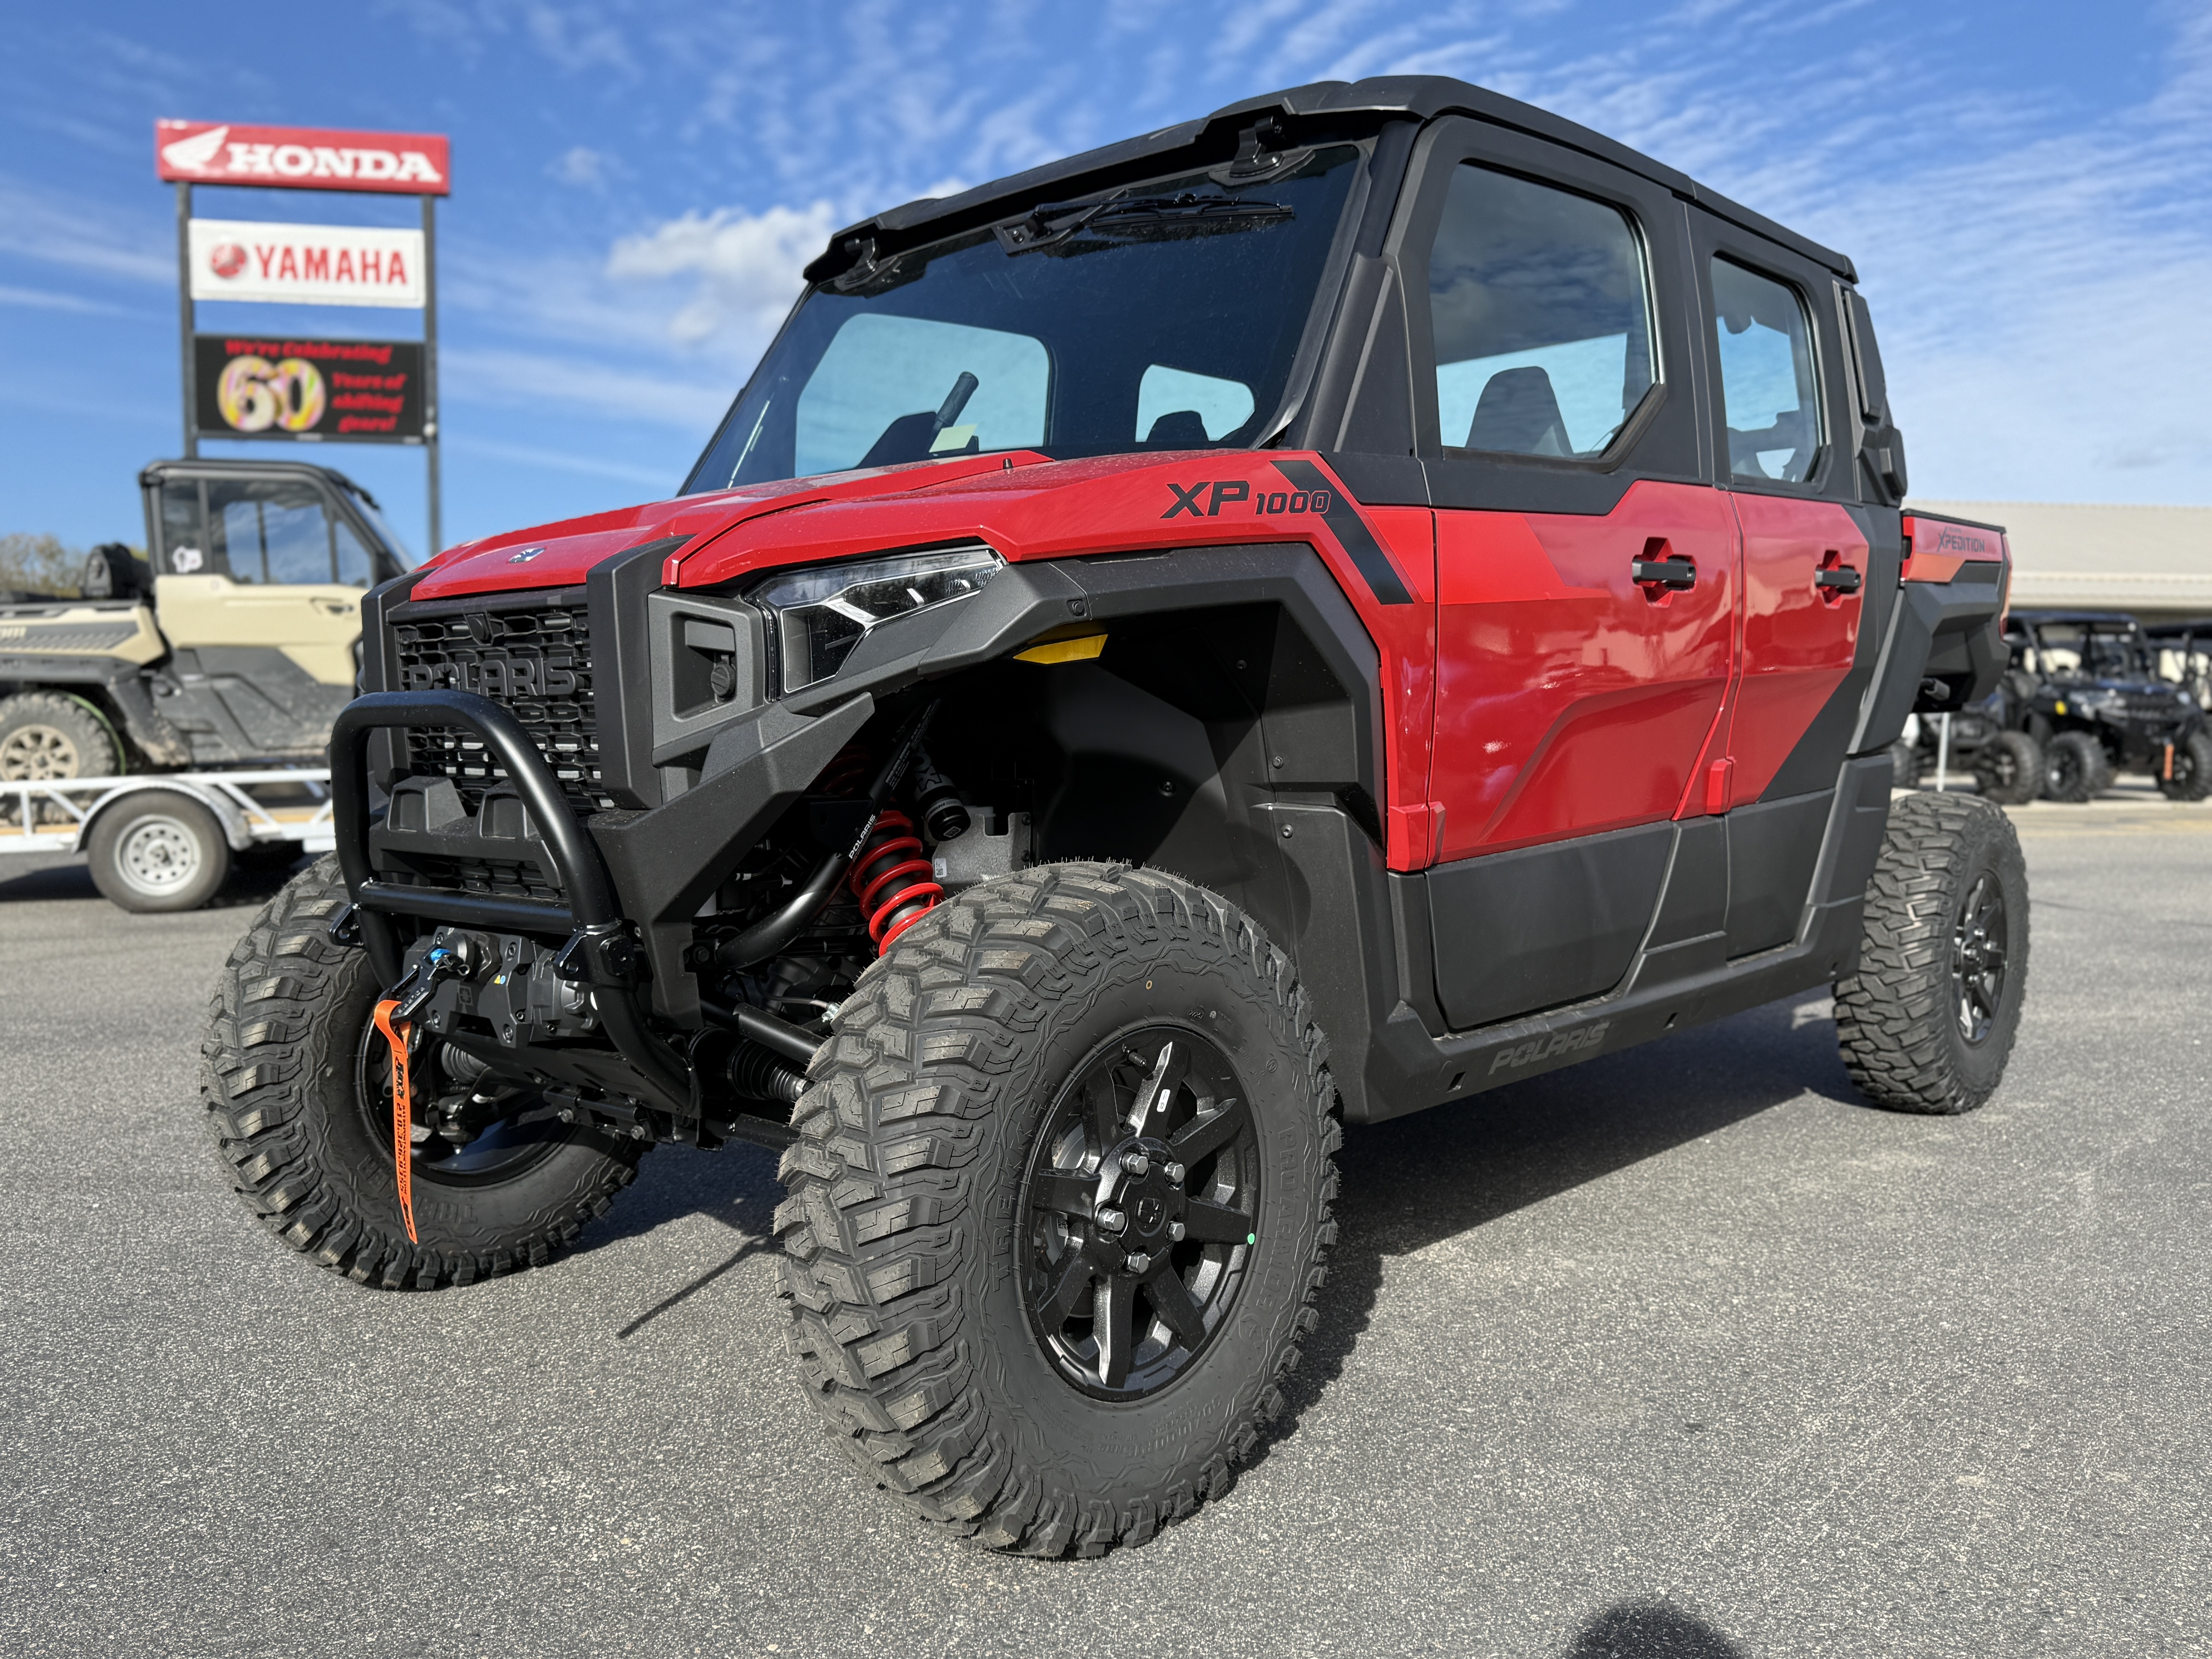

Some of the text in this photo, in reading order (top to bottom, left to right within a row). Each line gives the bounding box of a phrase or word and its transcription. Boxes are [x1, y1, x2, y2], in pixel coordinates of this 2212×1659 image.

[226, 143, 442, 183] HONDA
[255, 244, 407, 285] YAMAHA
[217, 355, 326, 432] 60
[1159, 481, 1331, 519] XP 1000
[1937, 526, 1985, 552] XPEDITION
[409, 656, 576, 697] POLARIS
[848, 814, 876, 859] POLARIS
[1488, 1022, 1610, 1075] POLARIS
[1255, 1128, 1299, 1313] PRO ARMOR
